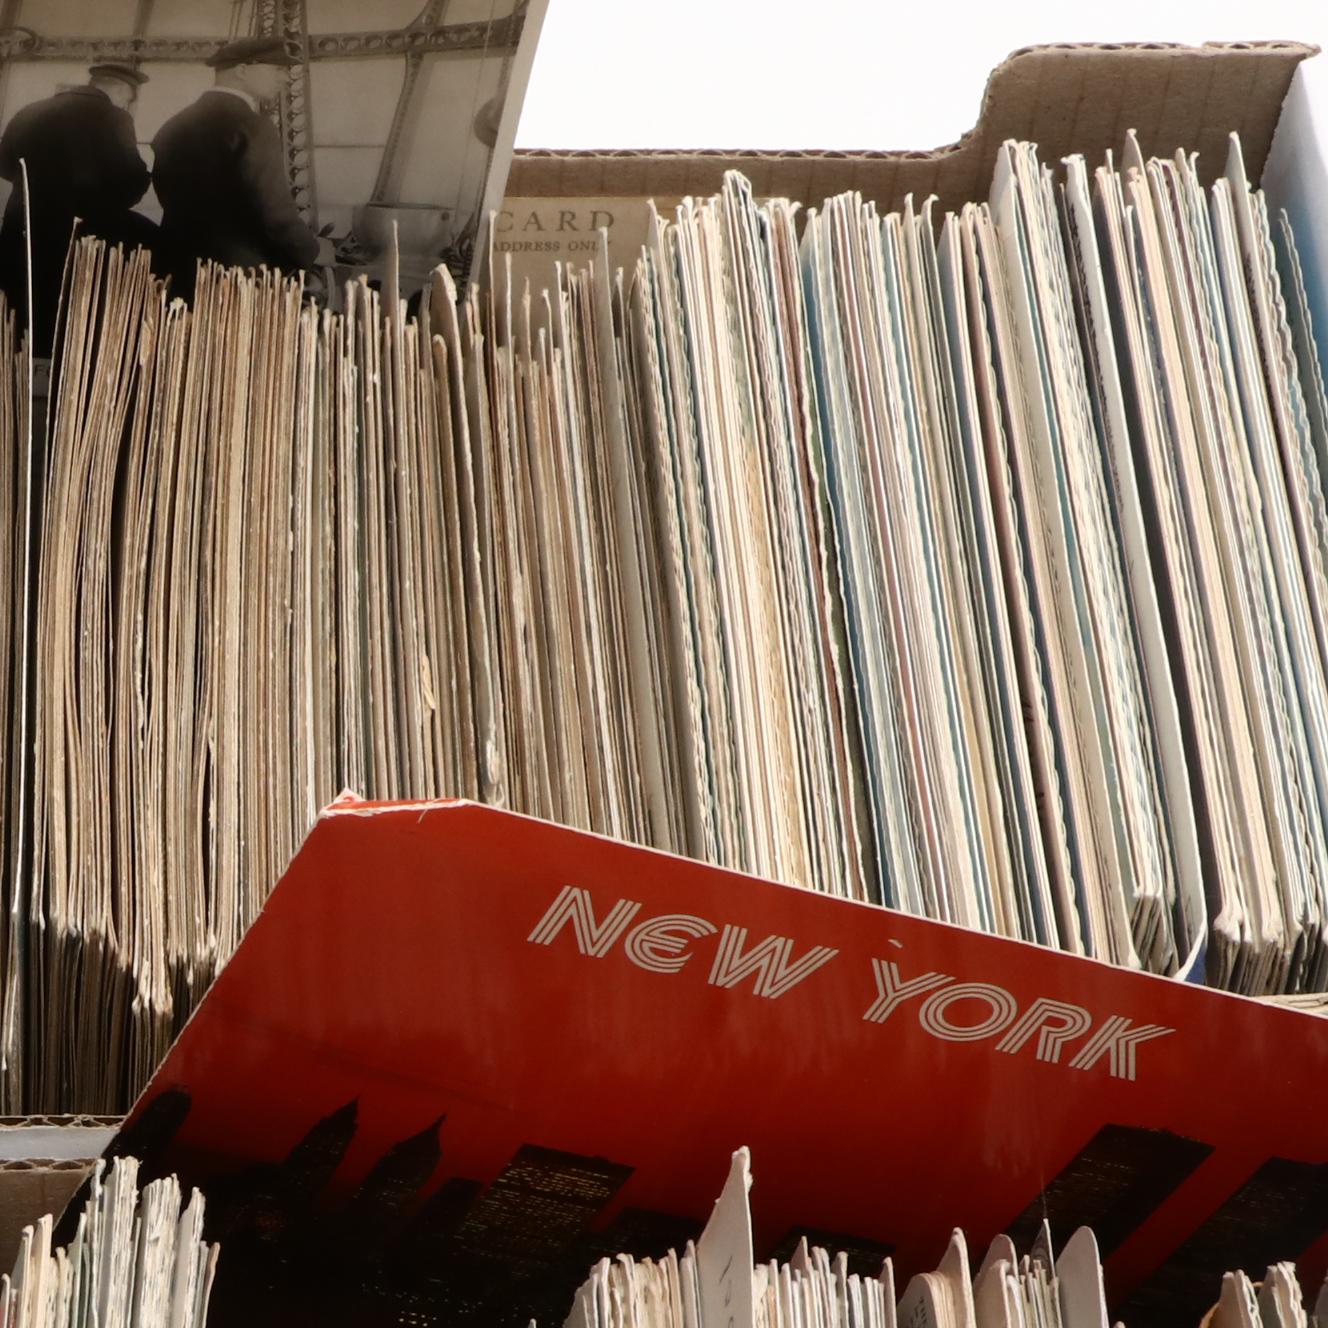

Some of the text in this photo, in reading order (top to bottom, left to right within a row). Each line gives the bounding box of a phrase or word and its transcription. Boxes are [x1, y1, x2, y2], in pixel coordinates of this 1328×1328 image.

[495, 209, 615, 233] CARD
[567, 240, 612, 252] ONL
[526, 884, 1177, 1081] NEW YORK
